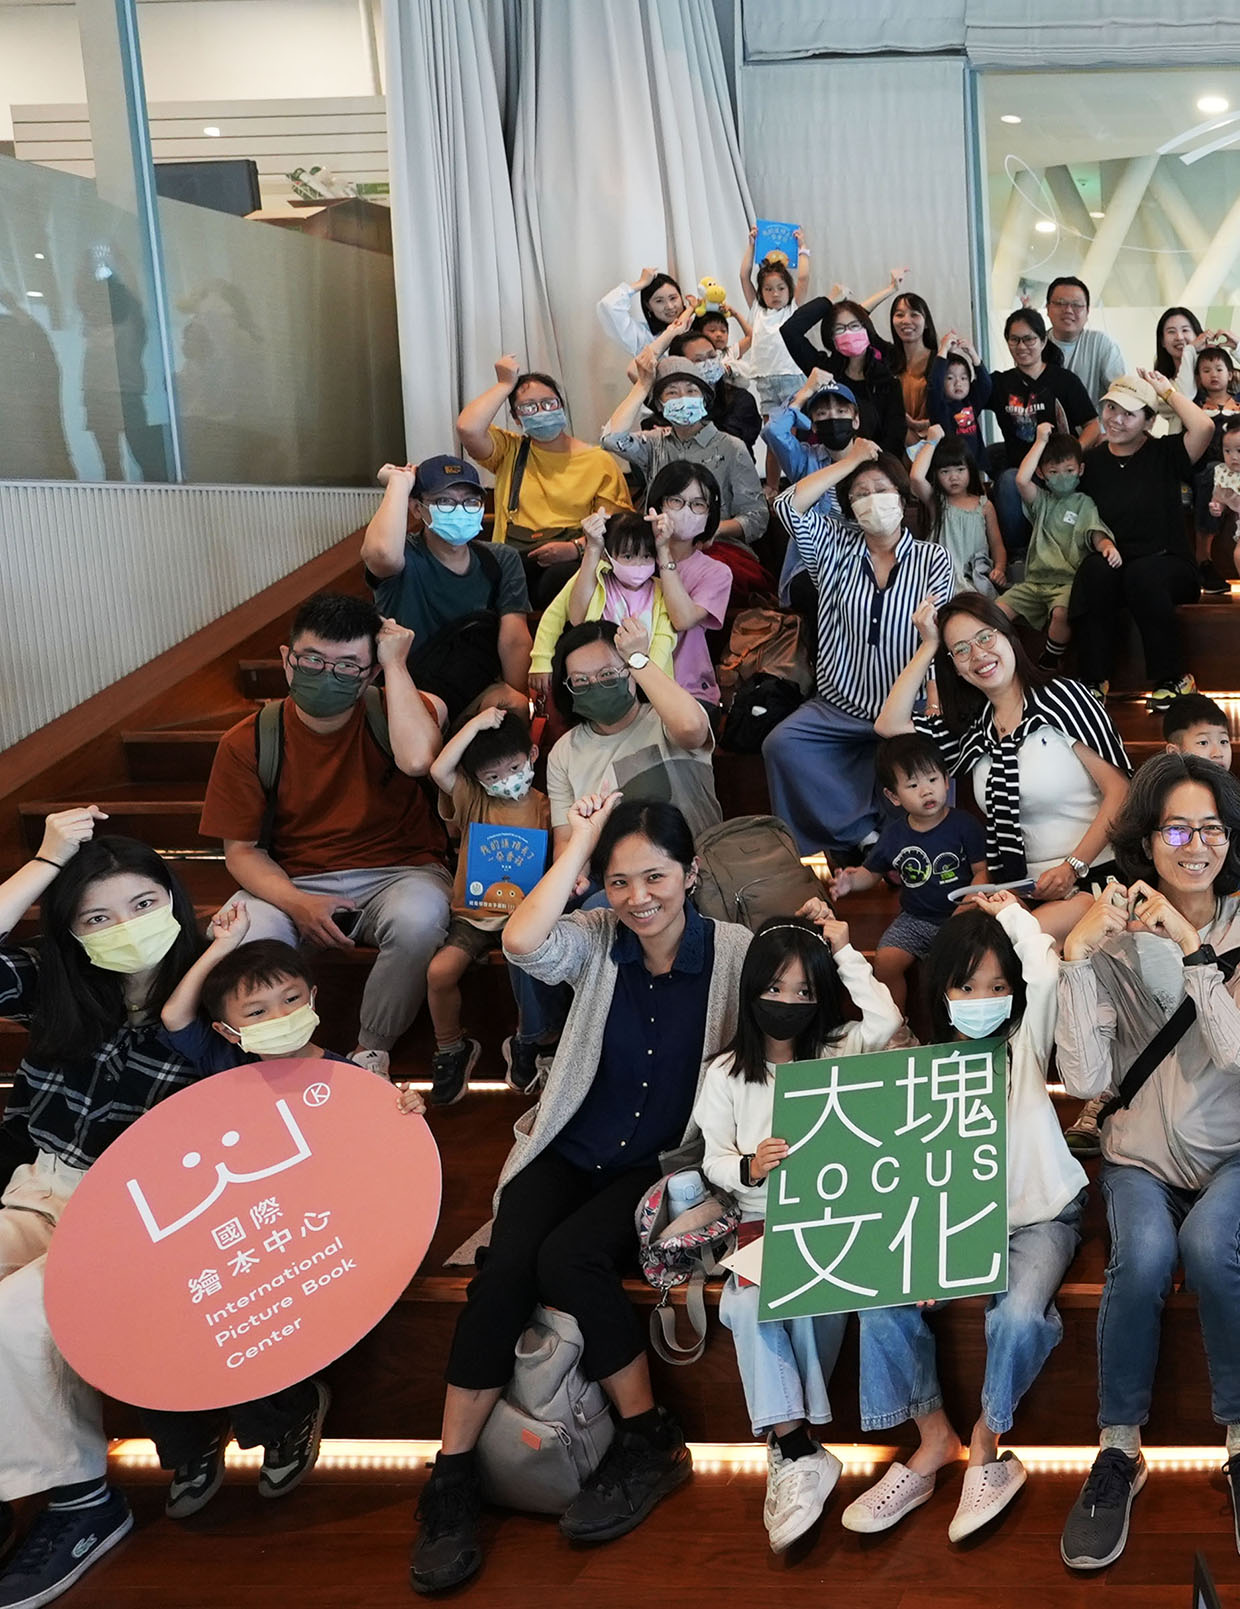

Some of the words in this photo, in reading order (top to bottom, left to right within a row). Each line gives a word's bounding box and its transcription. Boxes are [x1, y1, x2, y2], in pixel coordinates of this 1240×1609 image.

[784, 1050, 997, 1155] 大塊
[779, 1144, 998, 1205] LOCUS
[188, 1208, 331, 1303] 繪本中心
[211, 1196, 282, 1250] 國際
[768, 1192, 1001, 1310] 文化
[205, 1237, 344, 1326] International
[215, 1295, 293, 1348] Picture
[302, 1256, 357, 1296] Book
[226, 1316, 304, 1369] Center
